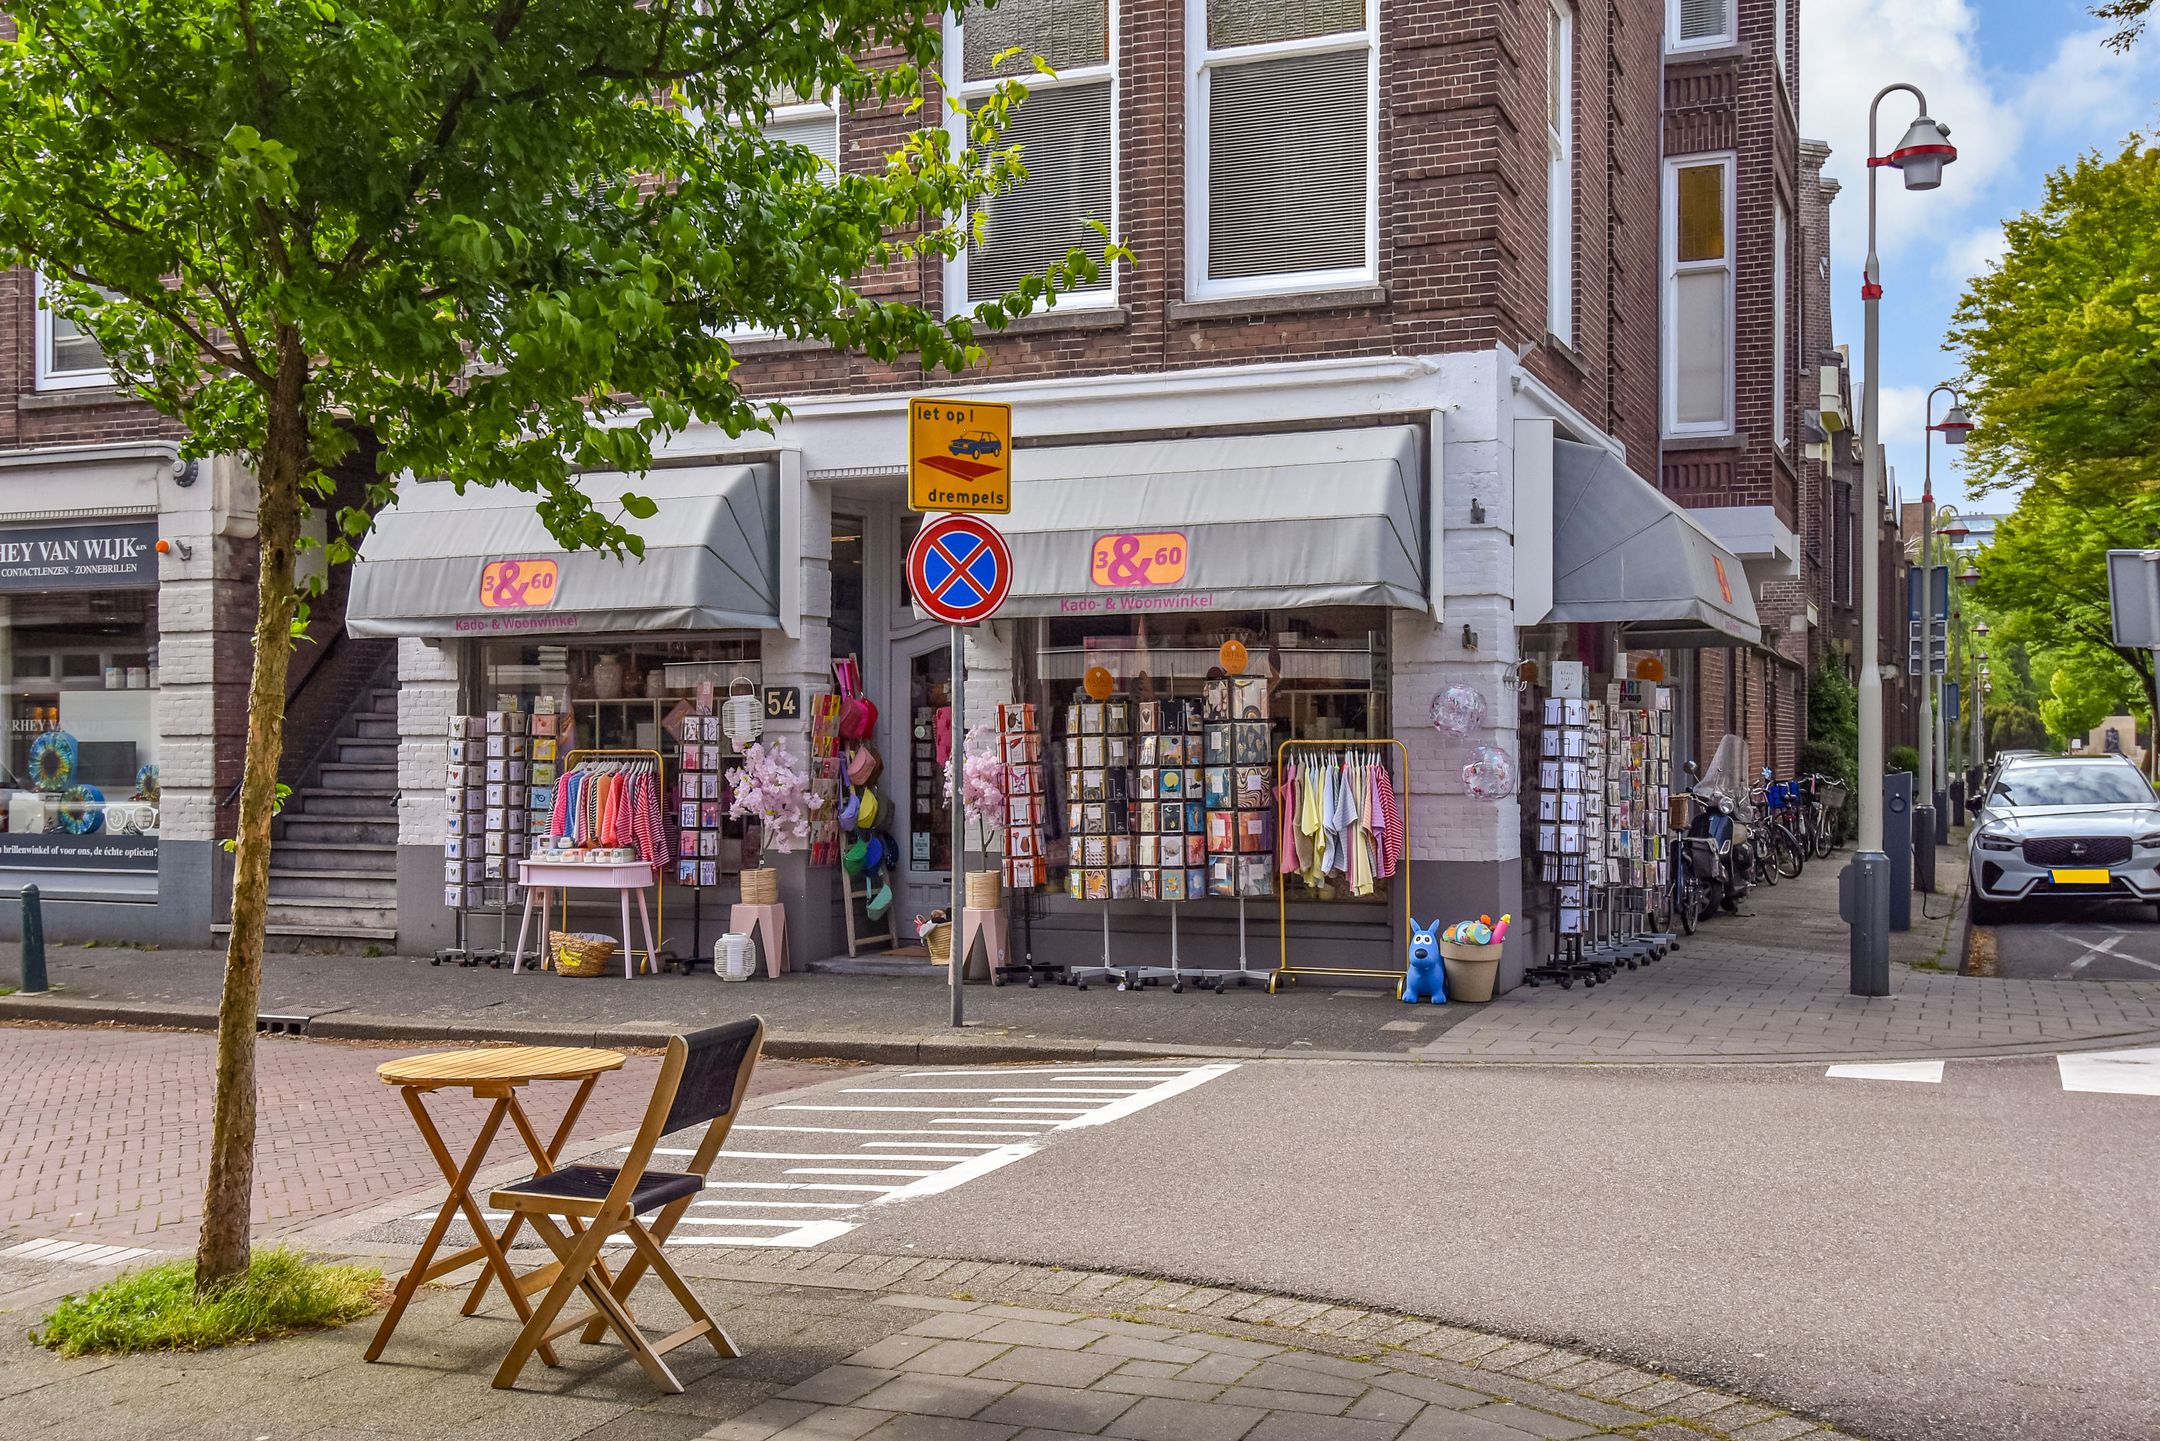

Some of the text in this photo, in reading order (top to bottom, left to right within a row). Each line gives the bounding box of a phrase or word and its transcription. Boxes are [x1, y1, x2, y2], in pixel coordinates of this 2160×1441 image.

[918, 406, 940, 420] let
[928, 489, 1004, 506] drempels
[38, 541, 78, 561] VAN
[83, 538, 138, 560] WIJK
[1, 566, 69, 577] CONTACTLENZEN
[75, 564, 137, 575] ZONNEBRILLEN
[1061, 593, 1213, 612] Kado- & Woonwinkel
[456, 614, 578, 631] Kado- & Woonwinkel
[1620, 681, 1641, 693] ART
[767, 690, 796, 715] 54
[1619, 695, 1641, 704] group
[3, 845, 50, 855] brillenwinkel
[51, 846, 59, 855] of
[60, 847, 76, 855] voor
[77, 848, 93, 857] ons,
[94, 847, 102, 856] de
[125, 848, 158, 858] opticien?
